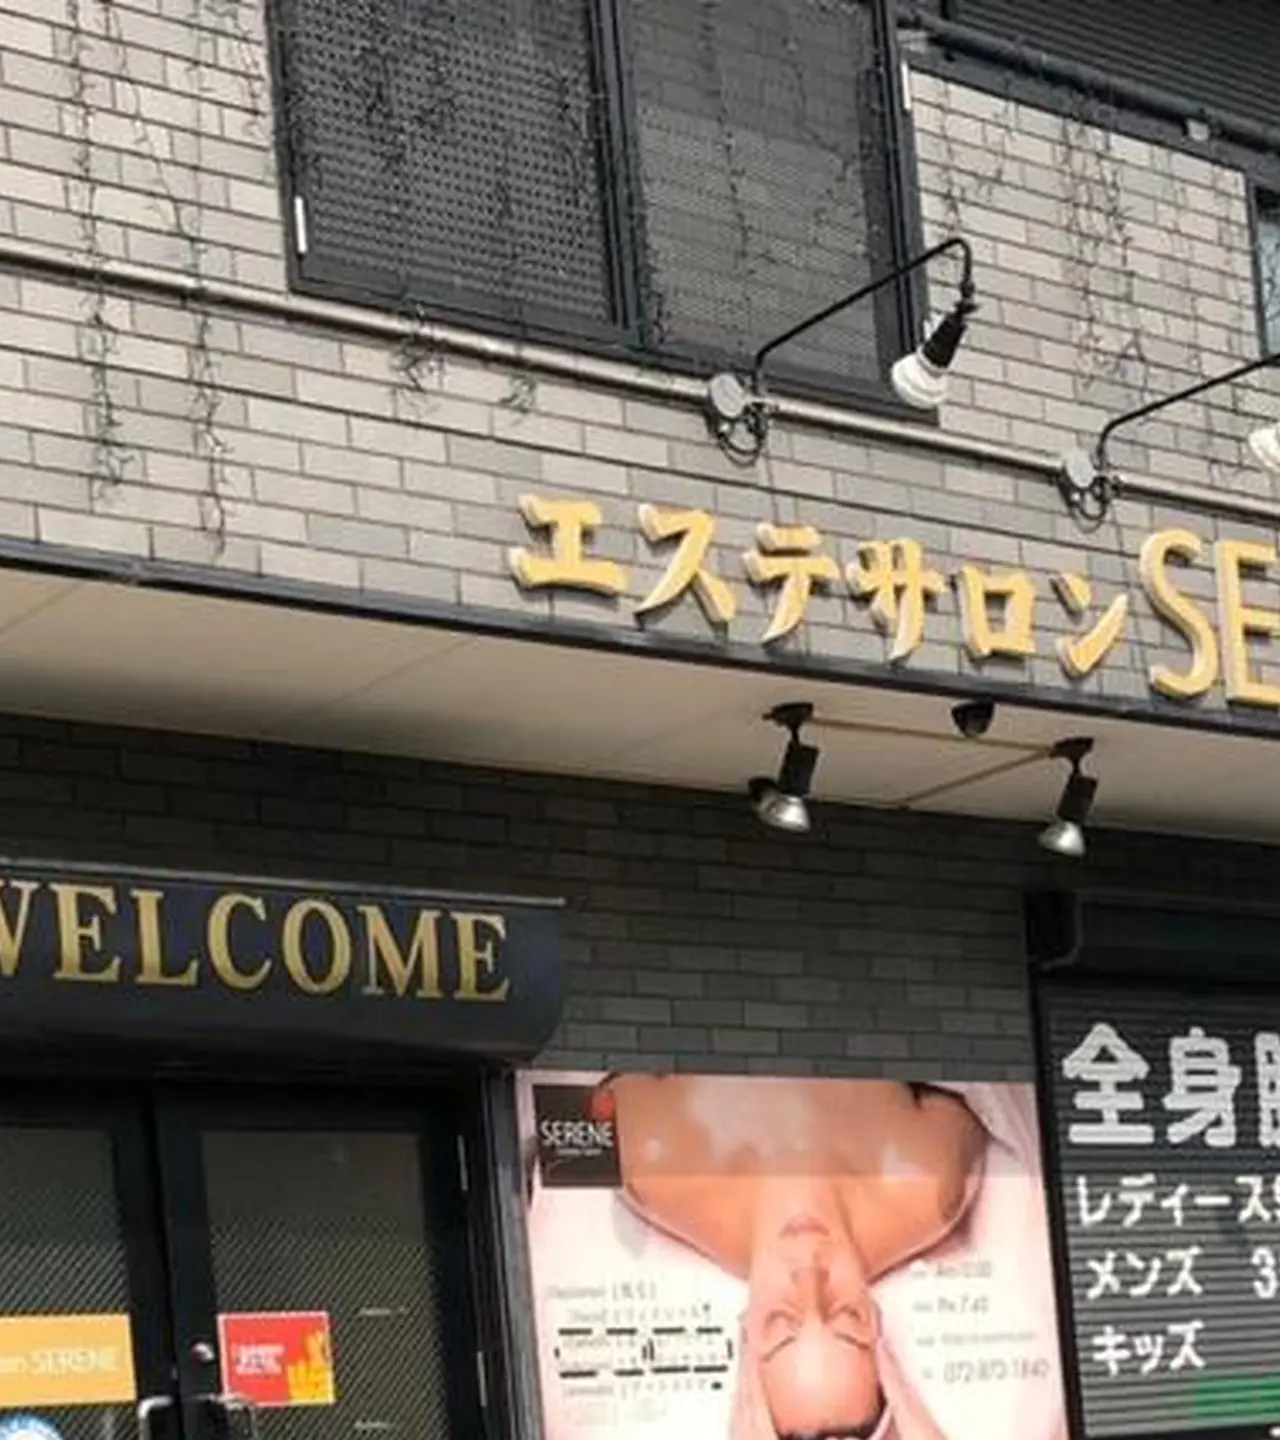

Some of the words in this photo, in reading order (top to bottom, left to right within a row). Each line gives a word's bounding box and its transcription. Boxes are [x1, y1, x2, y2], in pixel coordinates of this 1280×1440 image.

[507, 492, 1128, 680] エステサロン
[540, 1120, 614, 1148] SERENE
